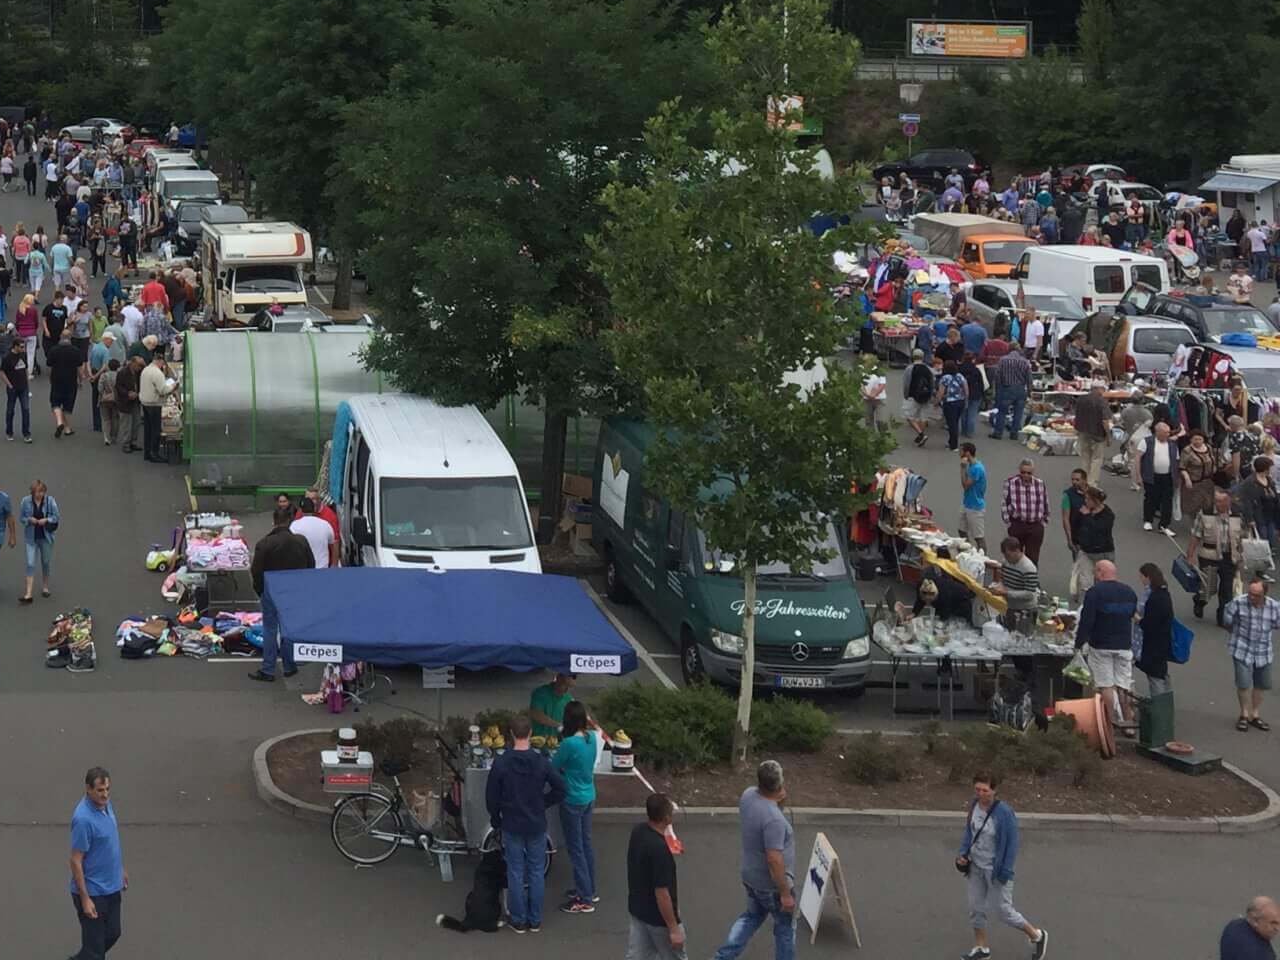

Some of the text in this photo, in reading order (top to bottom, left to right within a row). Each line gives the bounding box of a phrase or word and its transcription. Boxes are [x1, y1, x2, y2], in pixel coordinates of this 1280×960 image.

[730, 598, 848, 620] Ver Jahreszeiten
[298, 645, 338, 659] Crêpes
[575, 656, 616, 670] Crêpes
